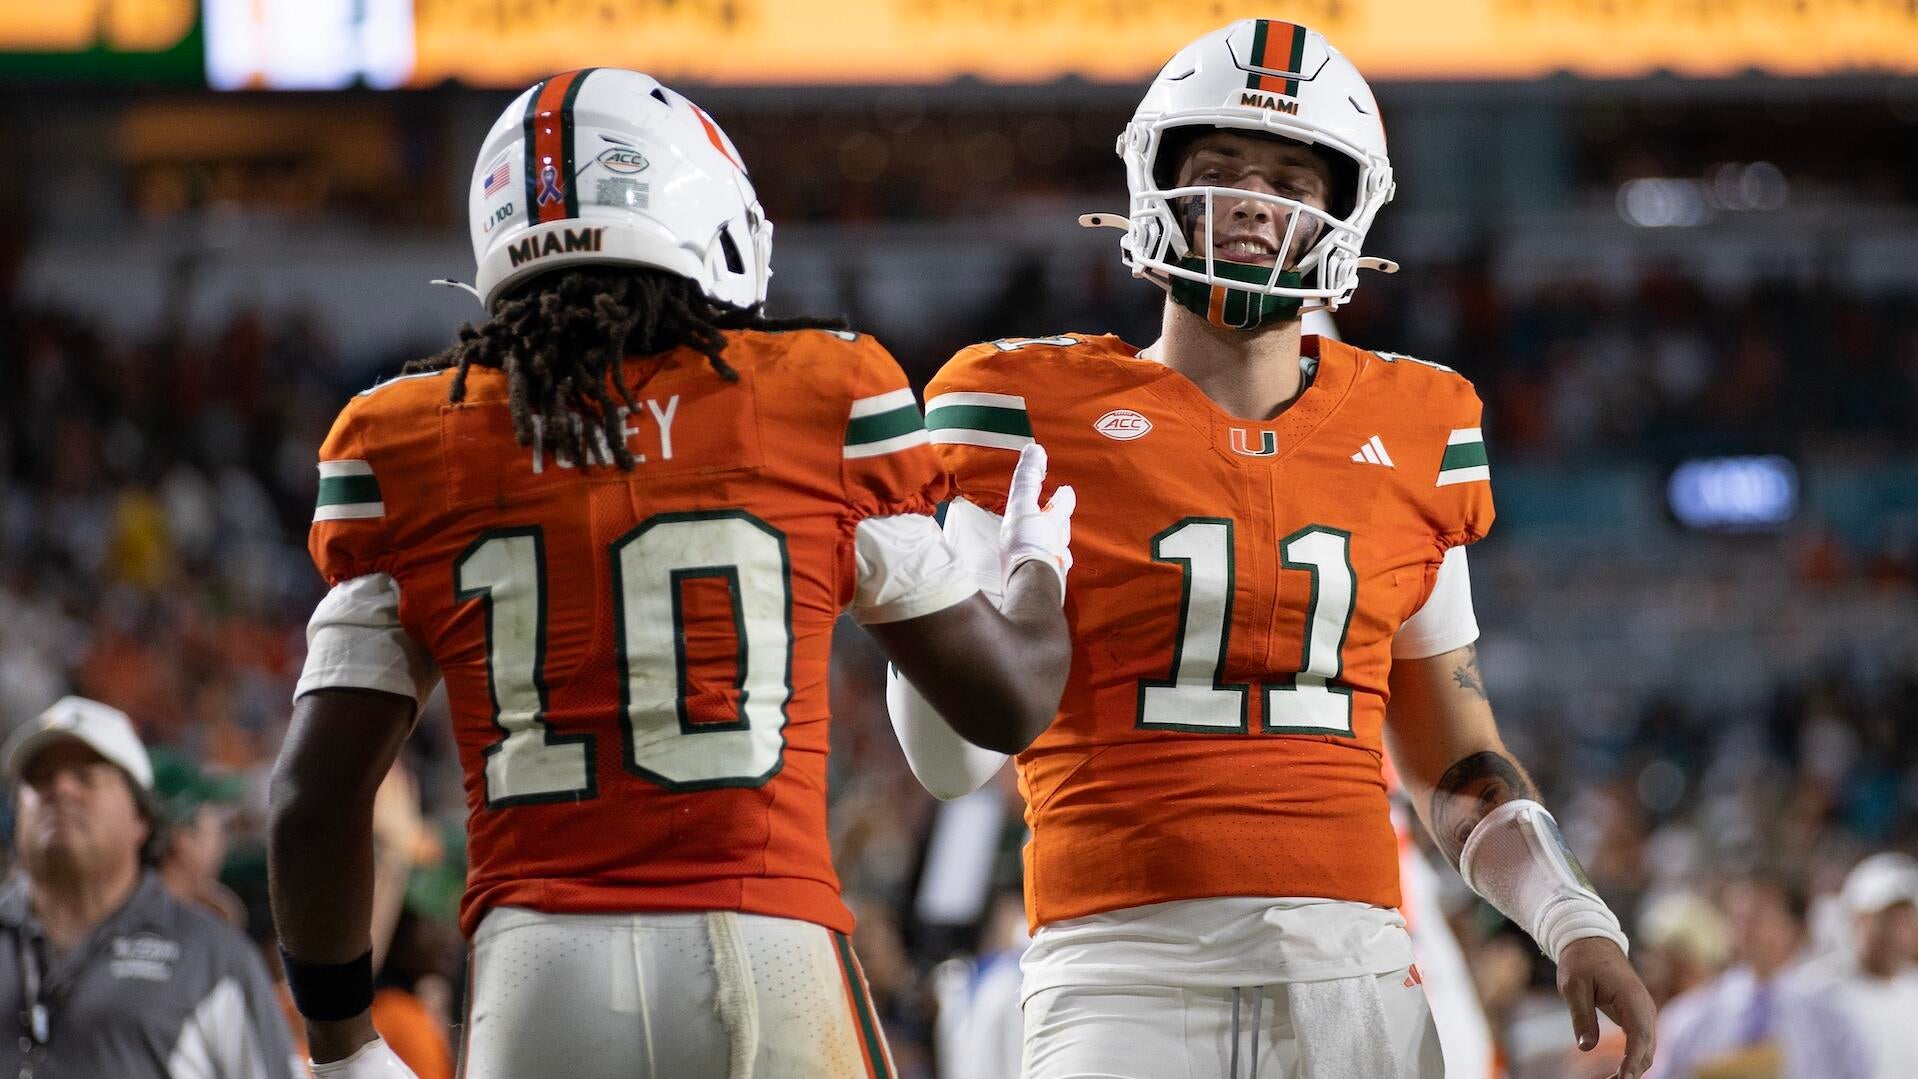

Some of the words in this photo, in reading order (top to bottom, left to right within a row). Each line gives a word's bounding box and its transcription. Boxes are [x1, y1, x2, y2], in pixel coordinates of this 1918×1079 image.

[1239, 92, 1299, 116] MIAMI
[606, 153, 641, 165] ACC
[496, 202, 513, 222] 100
[507, 227, 606, 268] MIAMI
[1104, 418, 1141, 430] ACC
[1229, 427, 1278, 457] U
[1135, 515, 1357, 738] 11
[454, 508, 793, 810] 10
